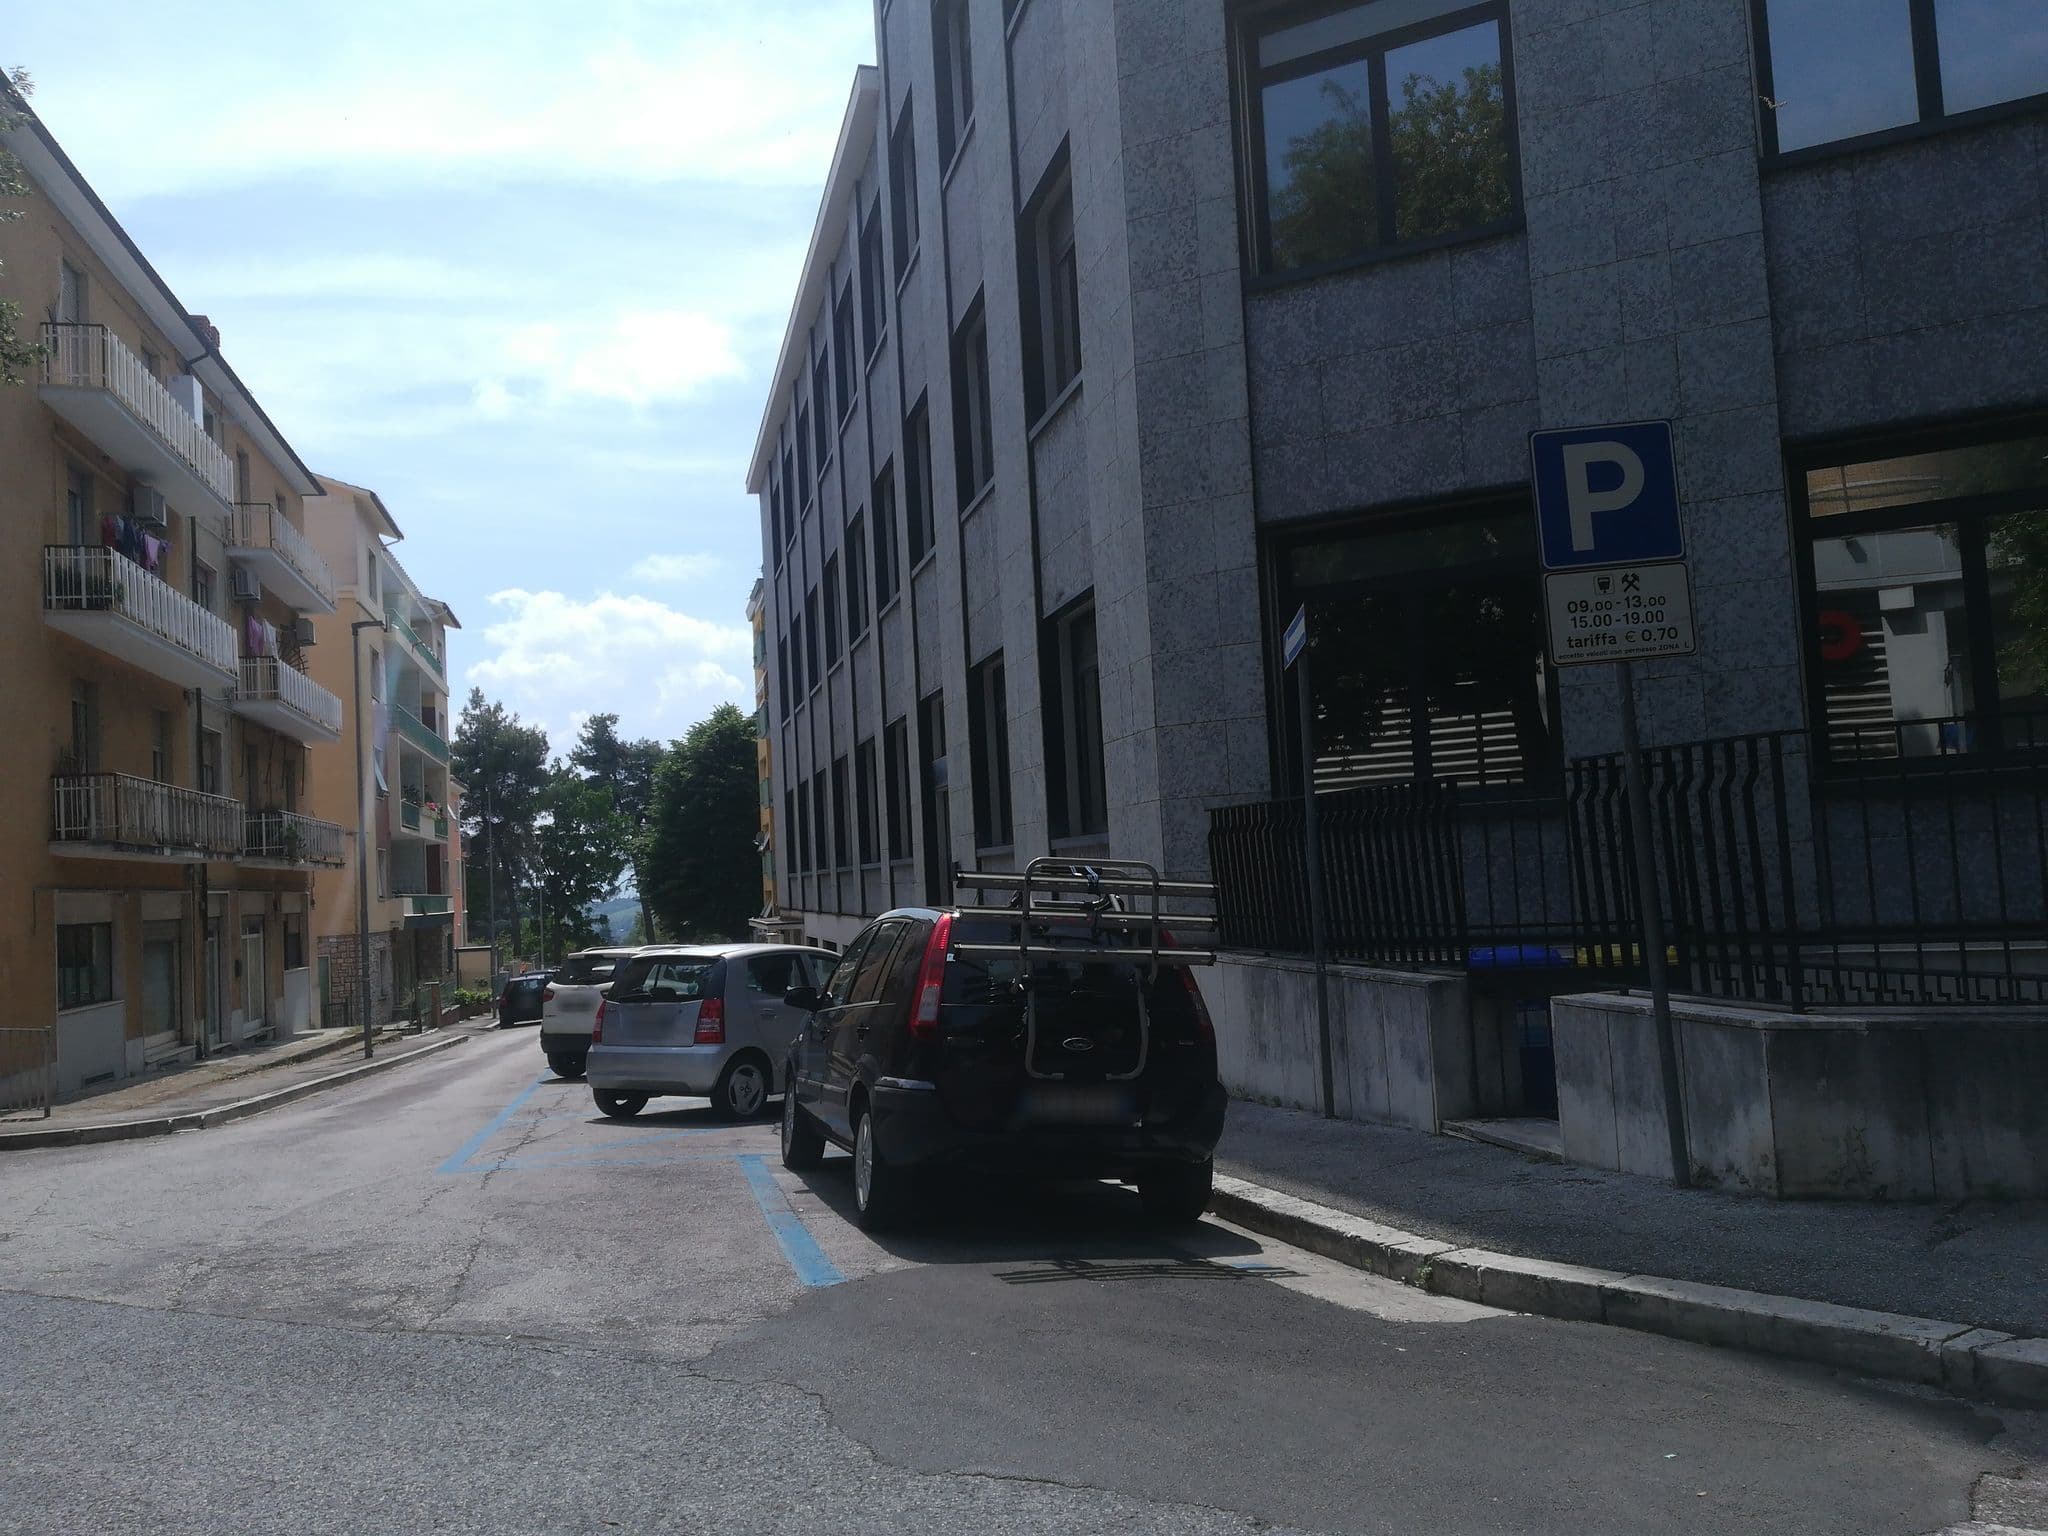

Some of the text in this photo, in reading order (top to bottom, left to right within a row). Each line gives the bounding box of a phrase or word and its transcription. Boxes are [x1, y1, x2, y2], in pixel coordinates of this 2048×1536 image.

[1562, 441, 1645, 552] P
[1567, 633, 1617, 649] tariffa
[1658, 643, 1680, 651] ZONA
